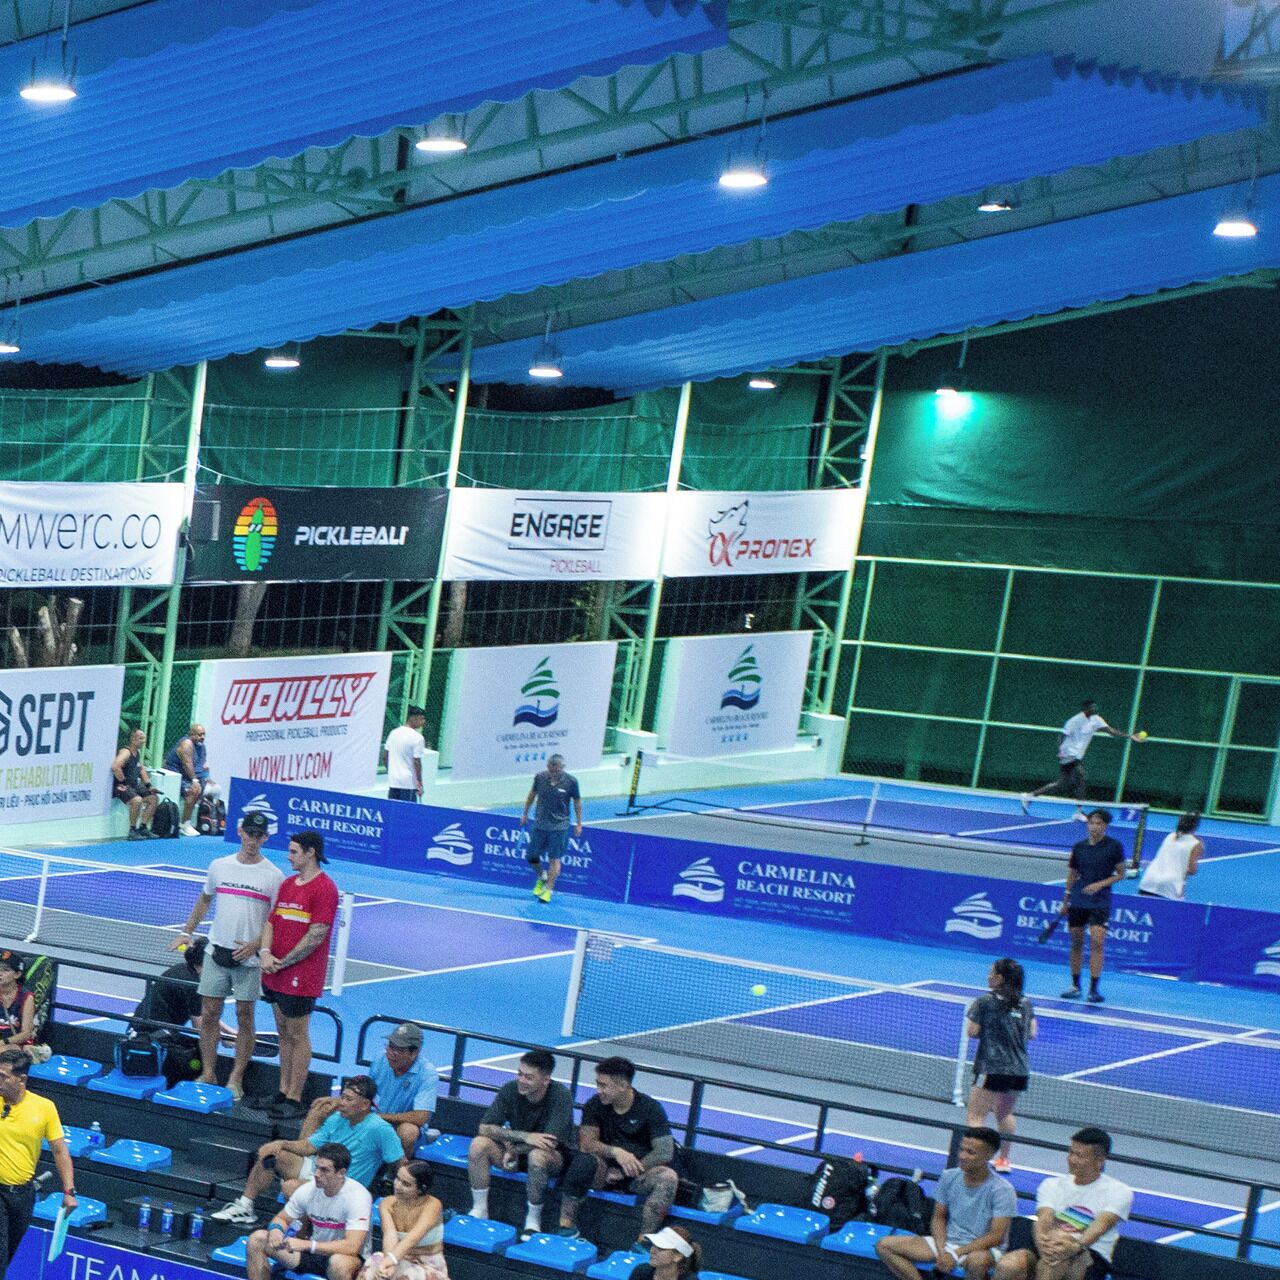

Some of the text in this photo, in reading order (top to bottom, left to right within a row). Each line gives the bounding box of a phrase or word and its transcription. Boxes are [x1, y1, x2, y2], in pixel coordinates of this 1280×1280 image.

[510, 512, 605, 540] ENGAGE
[71, 567, 152, 582] DESTINATIONS
[550, 560, 601, 573] PICKLEBALL
[221, 672, 377, 725] WOWLLY
[15, 691, 95, 756] SEPT
[5, 762, 94, 790] REHABILITATION
[248, 752, 333, 782] WOWLLY.COM
[288, 797, 384, 823] CARMELINA
[287, 814, 384, 838] BEACH RESORT
[738, 861, 856, 889] CARMELINA
[736, 879, 855, 905] BEACH RESORT
